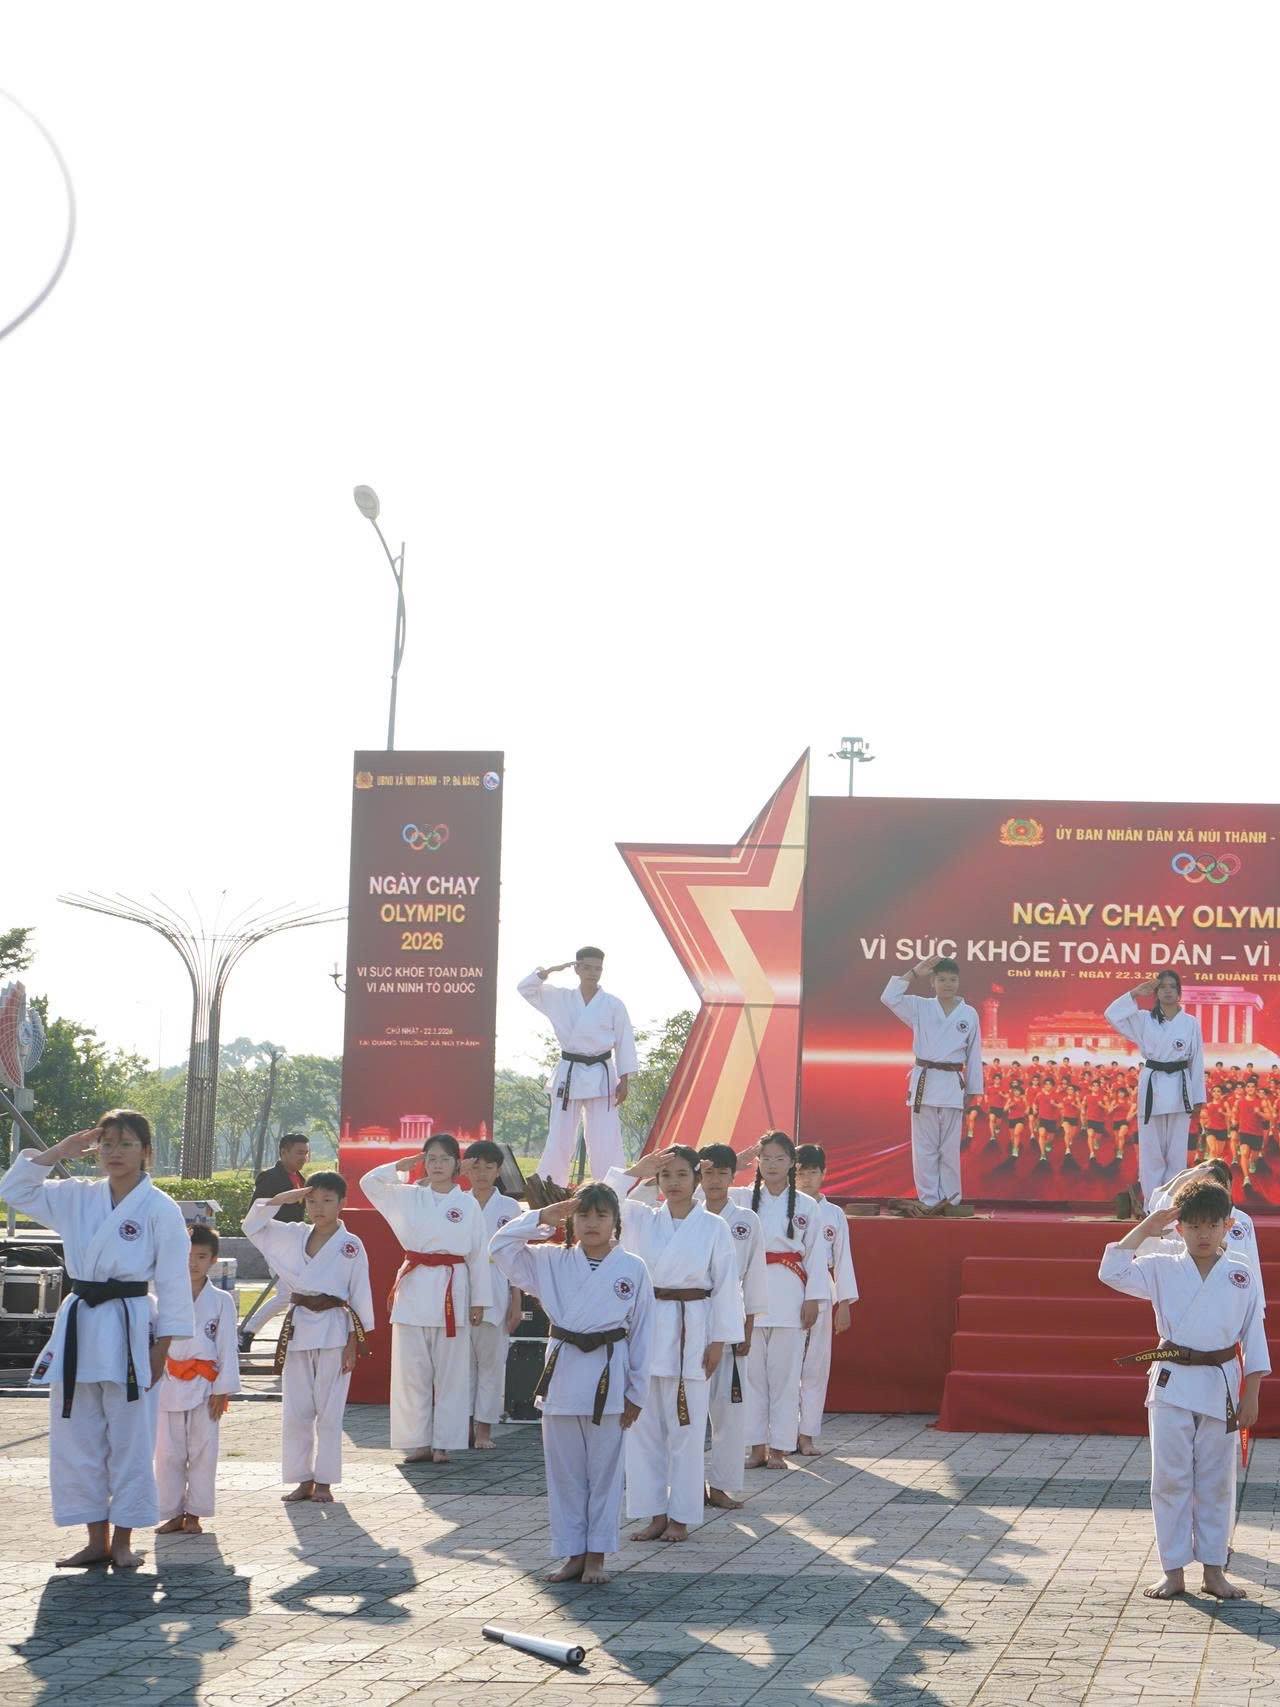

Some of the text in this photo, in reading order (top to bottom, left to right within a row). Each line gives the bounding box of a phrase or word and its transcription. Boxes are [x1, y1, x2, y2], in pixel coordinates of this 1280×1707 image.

[1056, 825, 1073, 841] ỦY
[1076, 828, 1103, 841] BAN
[1106, 827, 1143, 842] NHÂN
[1146, 827, 1173, 842] DÂN
[1177, 828, 1195, 843] XÃ
[1198, 828, 1221, 843] NÚI
[1225, 829, 1267, 844] THÀNH
[369, 872, 481, 899] NGÀY CHẠY
[380, 903, 466, 923] OLYMPIC
[1012, 899, 1094, 925] NGÀY
[1102, 904, 1185, 933] CHẠY
[400, 931, 444, 951] 2026
[860, 933, 886, 960] VÌ
[896, 936, 957, 961] SỨC
[967, 936, 1050, 963] KHỎE
[1058, 937, 1141, 965] TOÀN
[1150, 939, 1213, 966] DÂN
[1243, 940, 1270, 968] VÌ
[1115, 970, 1161, 980] 22.3.20
[379, 982, 395, 993] AN
[397, 982, 424, 993] NINH
